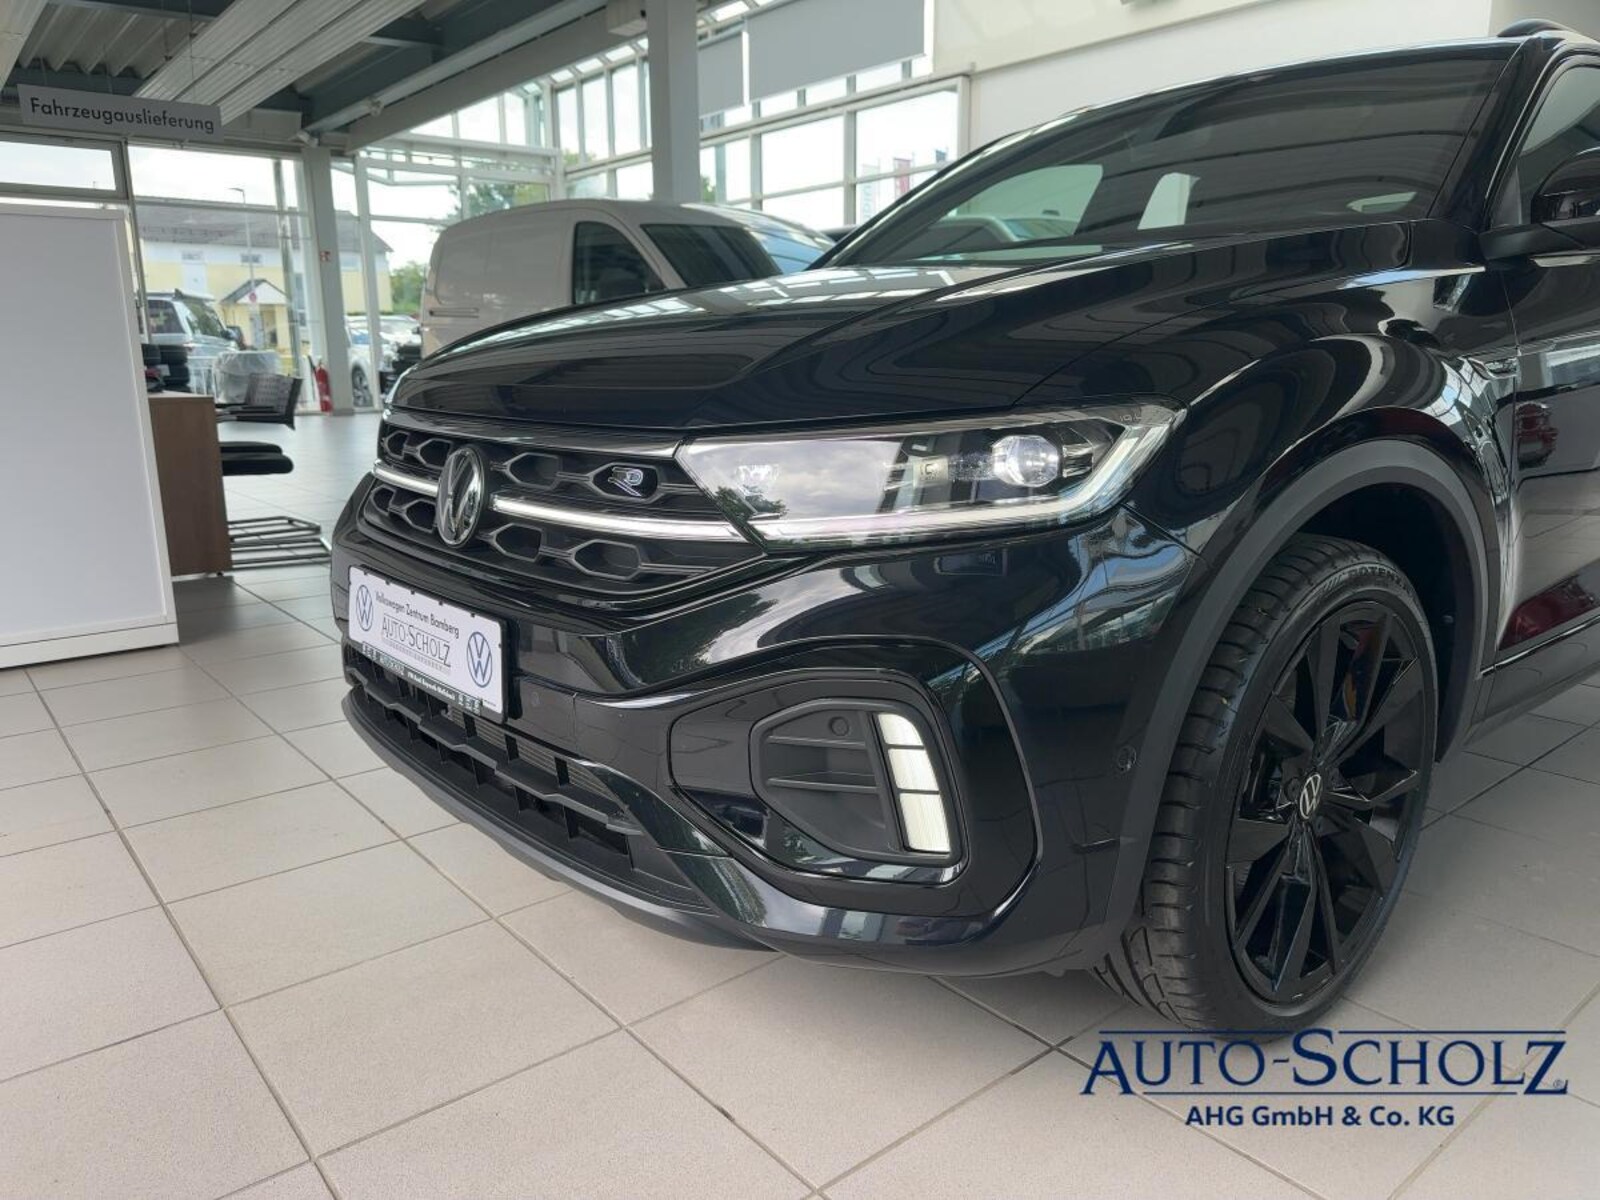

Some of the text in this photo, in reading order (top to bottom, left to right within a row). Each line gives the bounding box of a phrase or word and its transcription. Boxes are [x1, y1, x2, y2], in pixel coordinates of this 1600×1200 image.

[30, 97, 214, 134] Fahrzeugauslieferung
[406, 603, 429, 623] Zentrum
[430, 613, 460, 639] Bamberg
